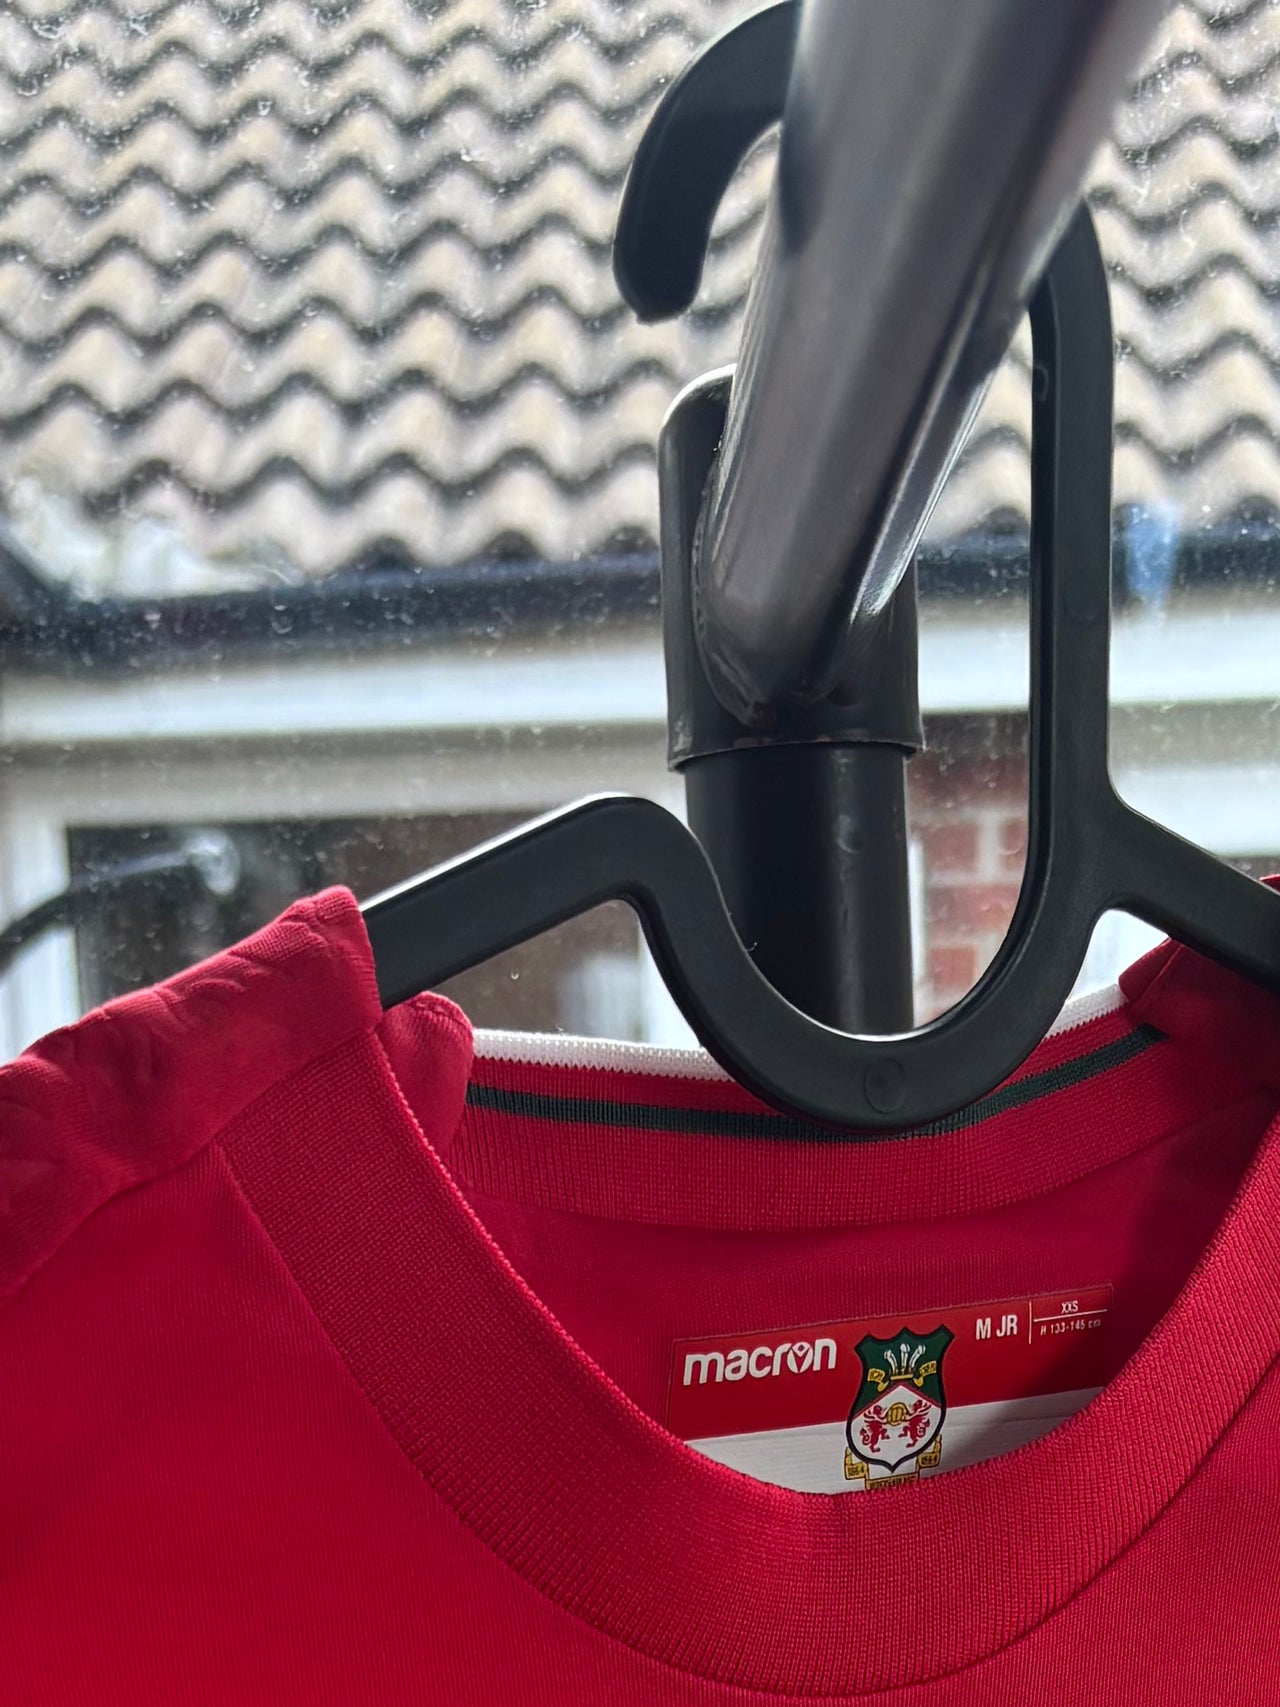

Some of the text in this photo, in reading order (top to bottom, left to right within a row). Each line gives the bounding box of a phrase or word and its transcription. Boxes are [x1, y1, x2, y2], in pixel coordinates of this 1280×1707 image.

[975, 1314, 1018, 1340] M JR
[683, 1337, 837, 1386] macron
